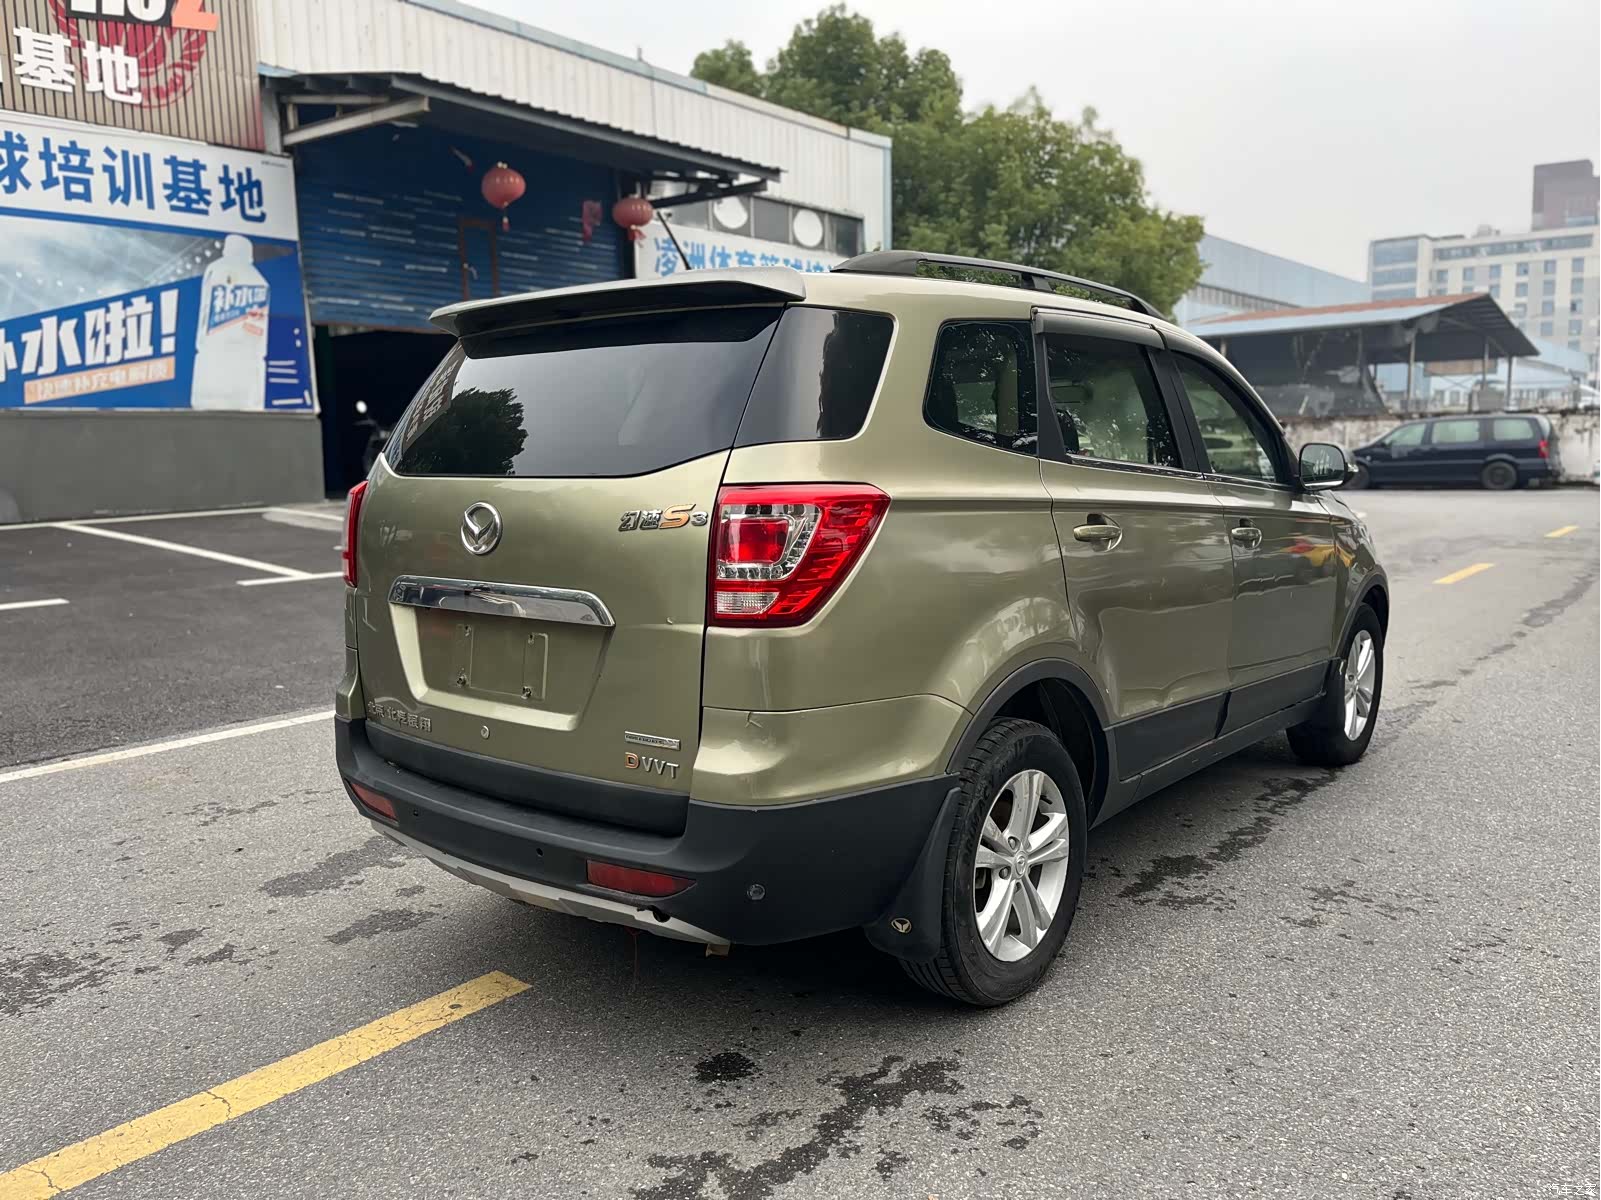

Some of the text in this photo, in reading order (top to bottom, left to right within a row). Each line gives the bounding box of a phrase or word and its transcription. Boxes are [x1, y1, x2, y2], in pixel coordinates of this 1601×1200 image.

[0, 26, 142, 104] 基地
[0, 130, 267, 223] 球培训基地
